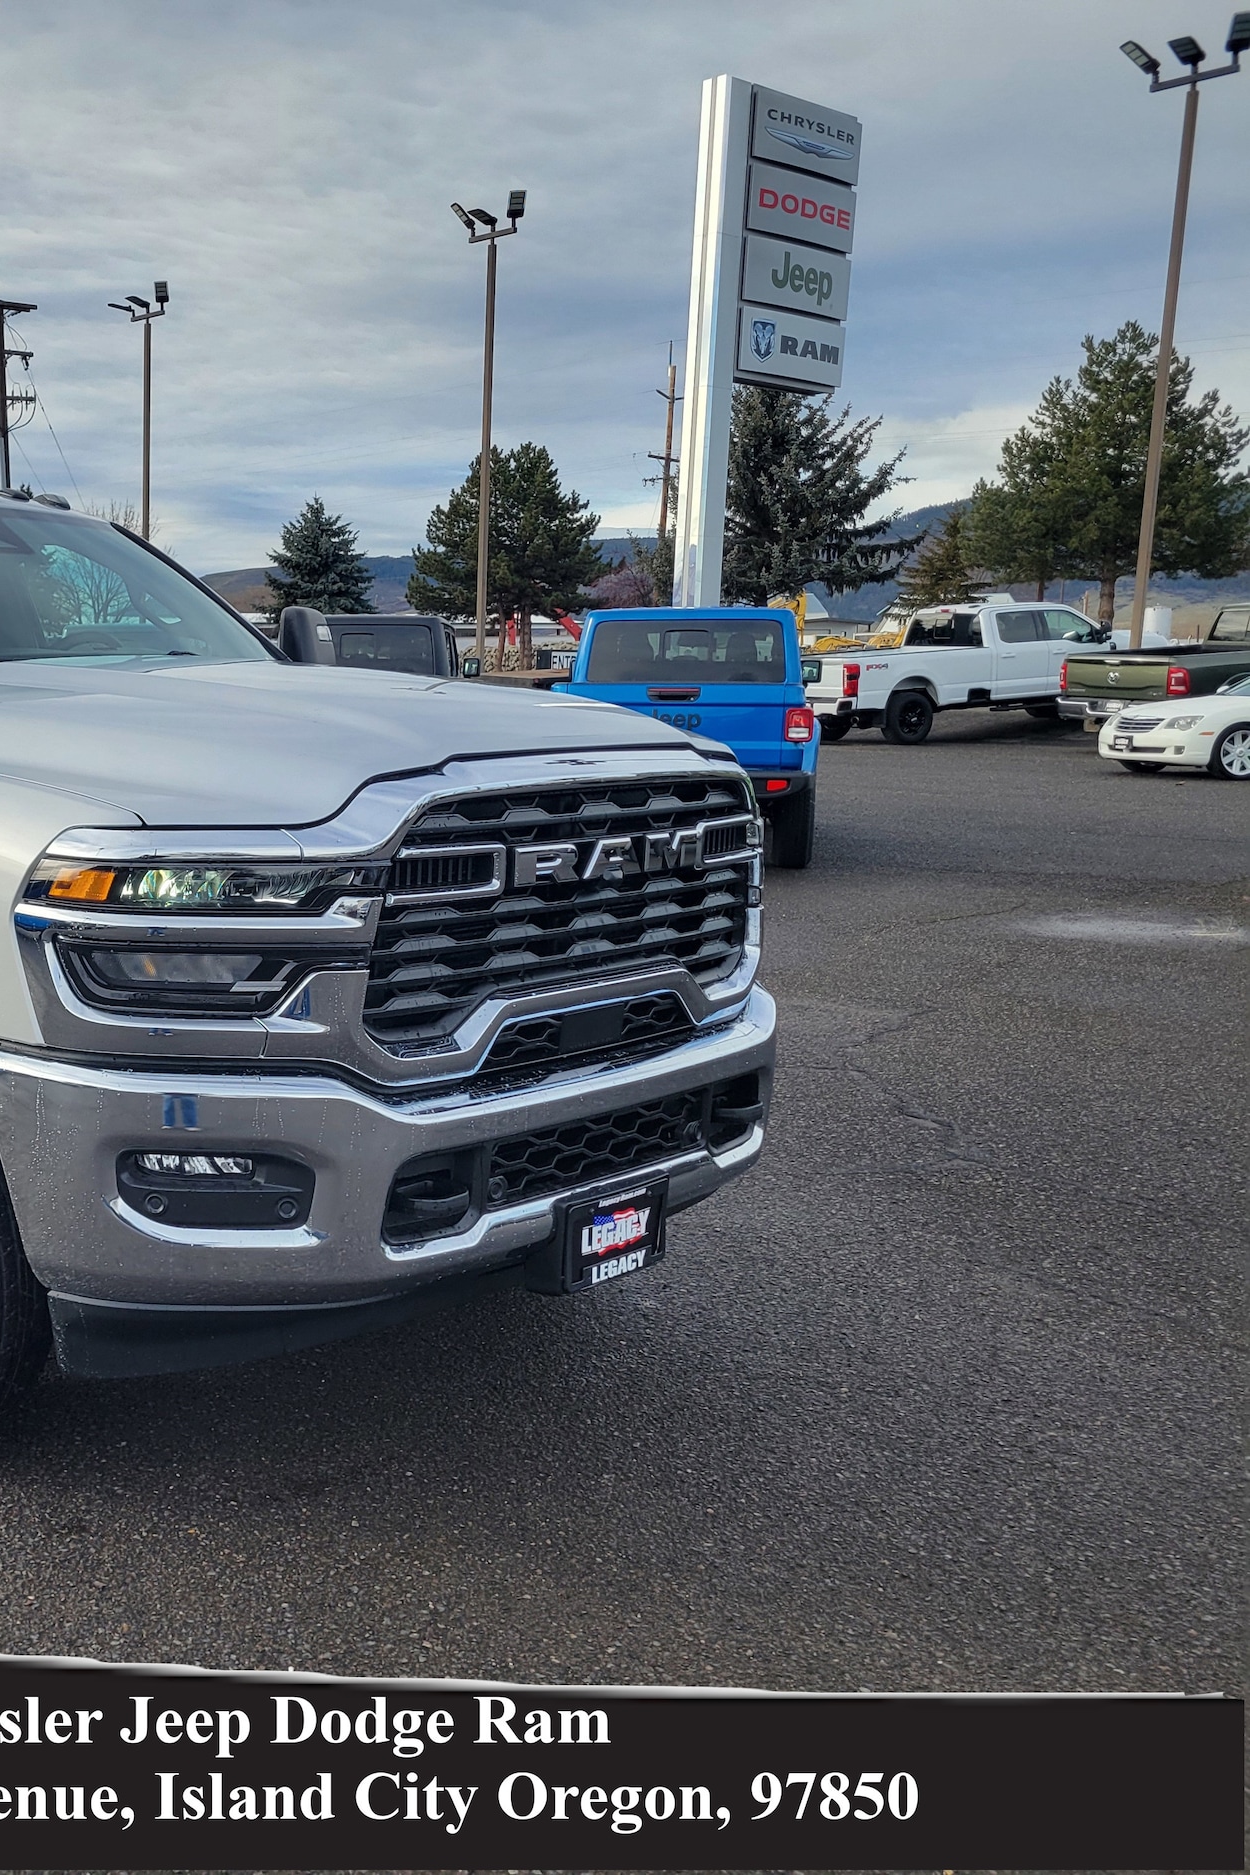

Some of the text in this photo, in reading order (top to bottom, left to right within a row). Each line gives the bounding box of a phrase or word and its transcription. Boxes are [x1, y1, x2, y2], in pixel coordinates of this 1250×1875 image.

[767, 108, 855, 146] CHRYSLER
[758, 188, 851, 230] DODGE
[771, 251, 833, 305] Jeep
[779, 335, 840, 365] RAM
[513, 829, 697, 888] RAM
[581, 1209, 650, 1254] LEGACY
[591, 1250, 646, 1284] LEGACY
